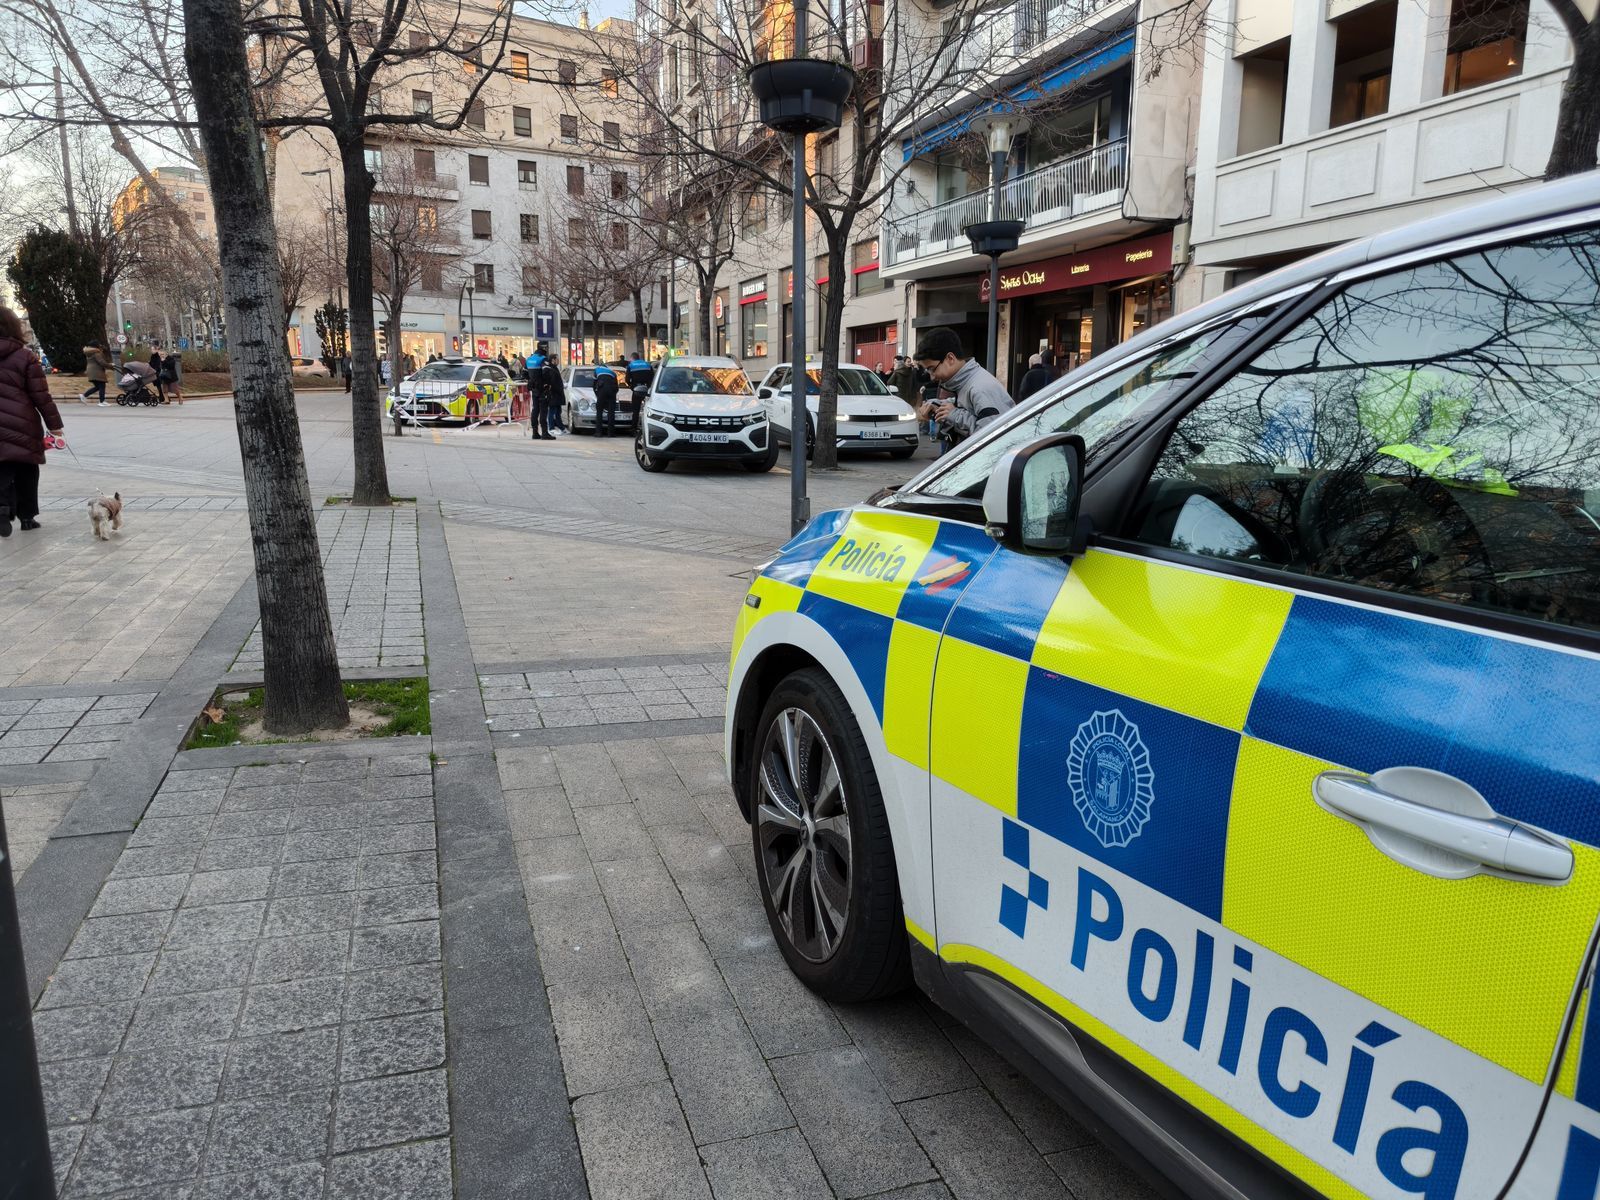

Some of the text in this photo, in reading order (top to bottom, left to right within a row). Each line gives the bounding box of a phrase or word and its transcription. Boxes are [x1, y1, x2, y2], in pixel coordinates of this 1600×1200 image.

[537, 314, 552, 334] T
[828, 538, 906, 583] Policía
[1069, 865, 1469, 1200] Policía
